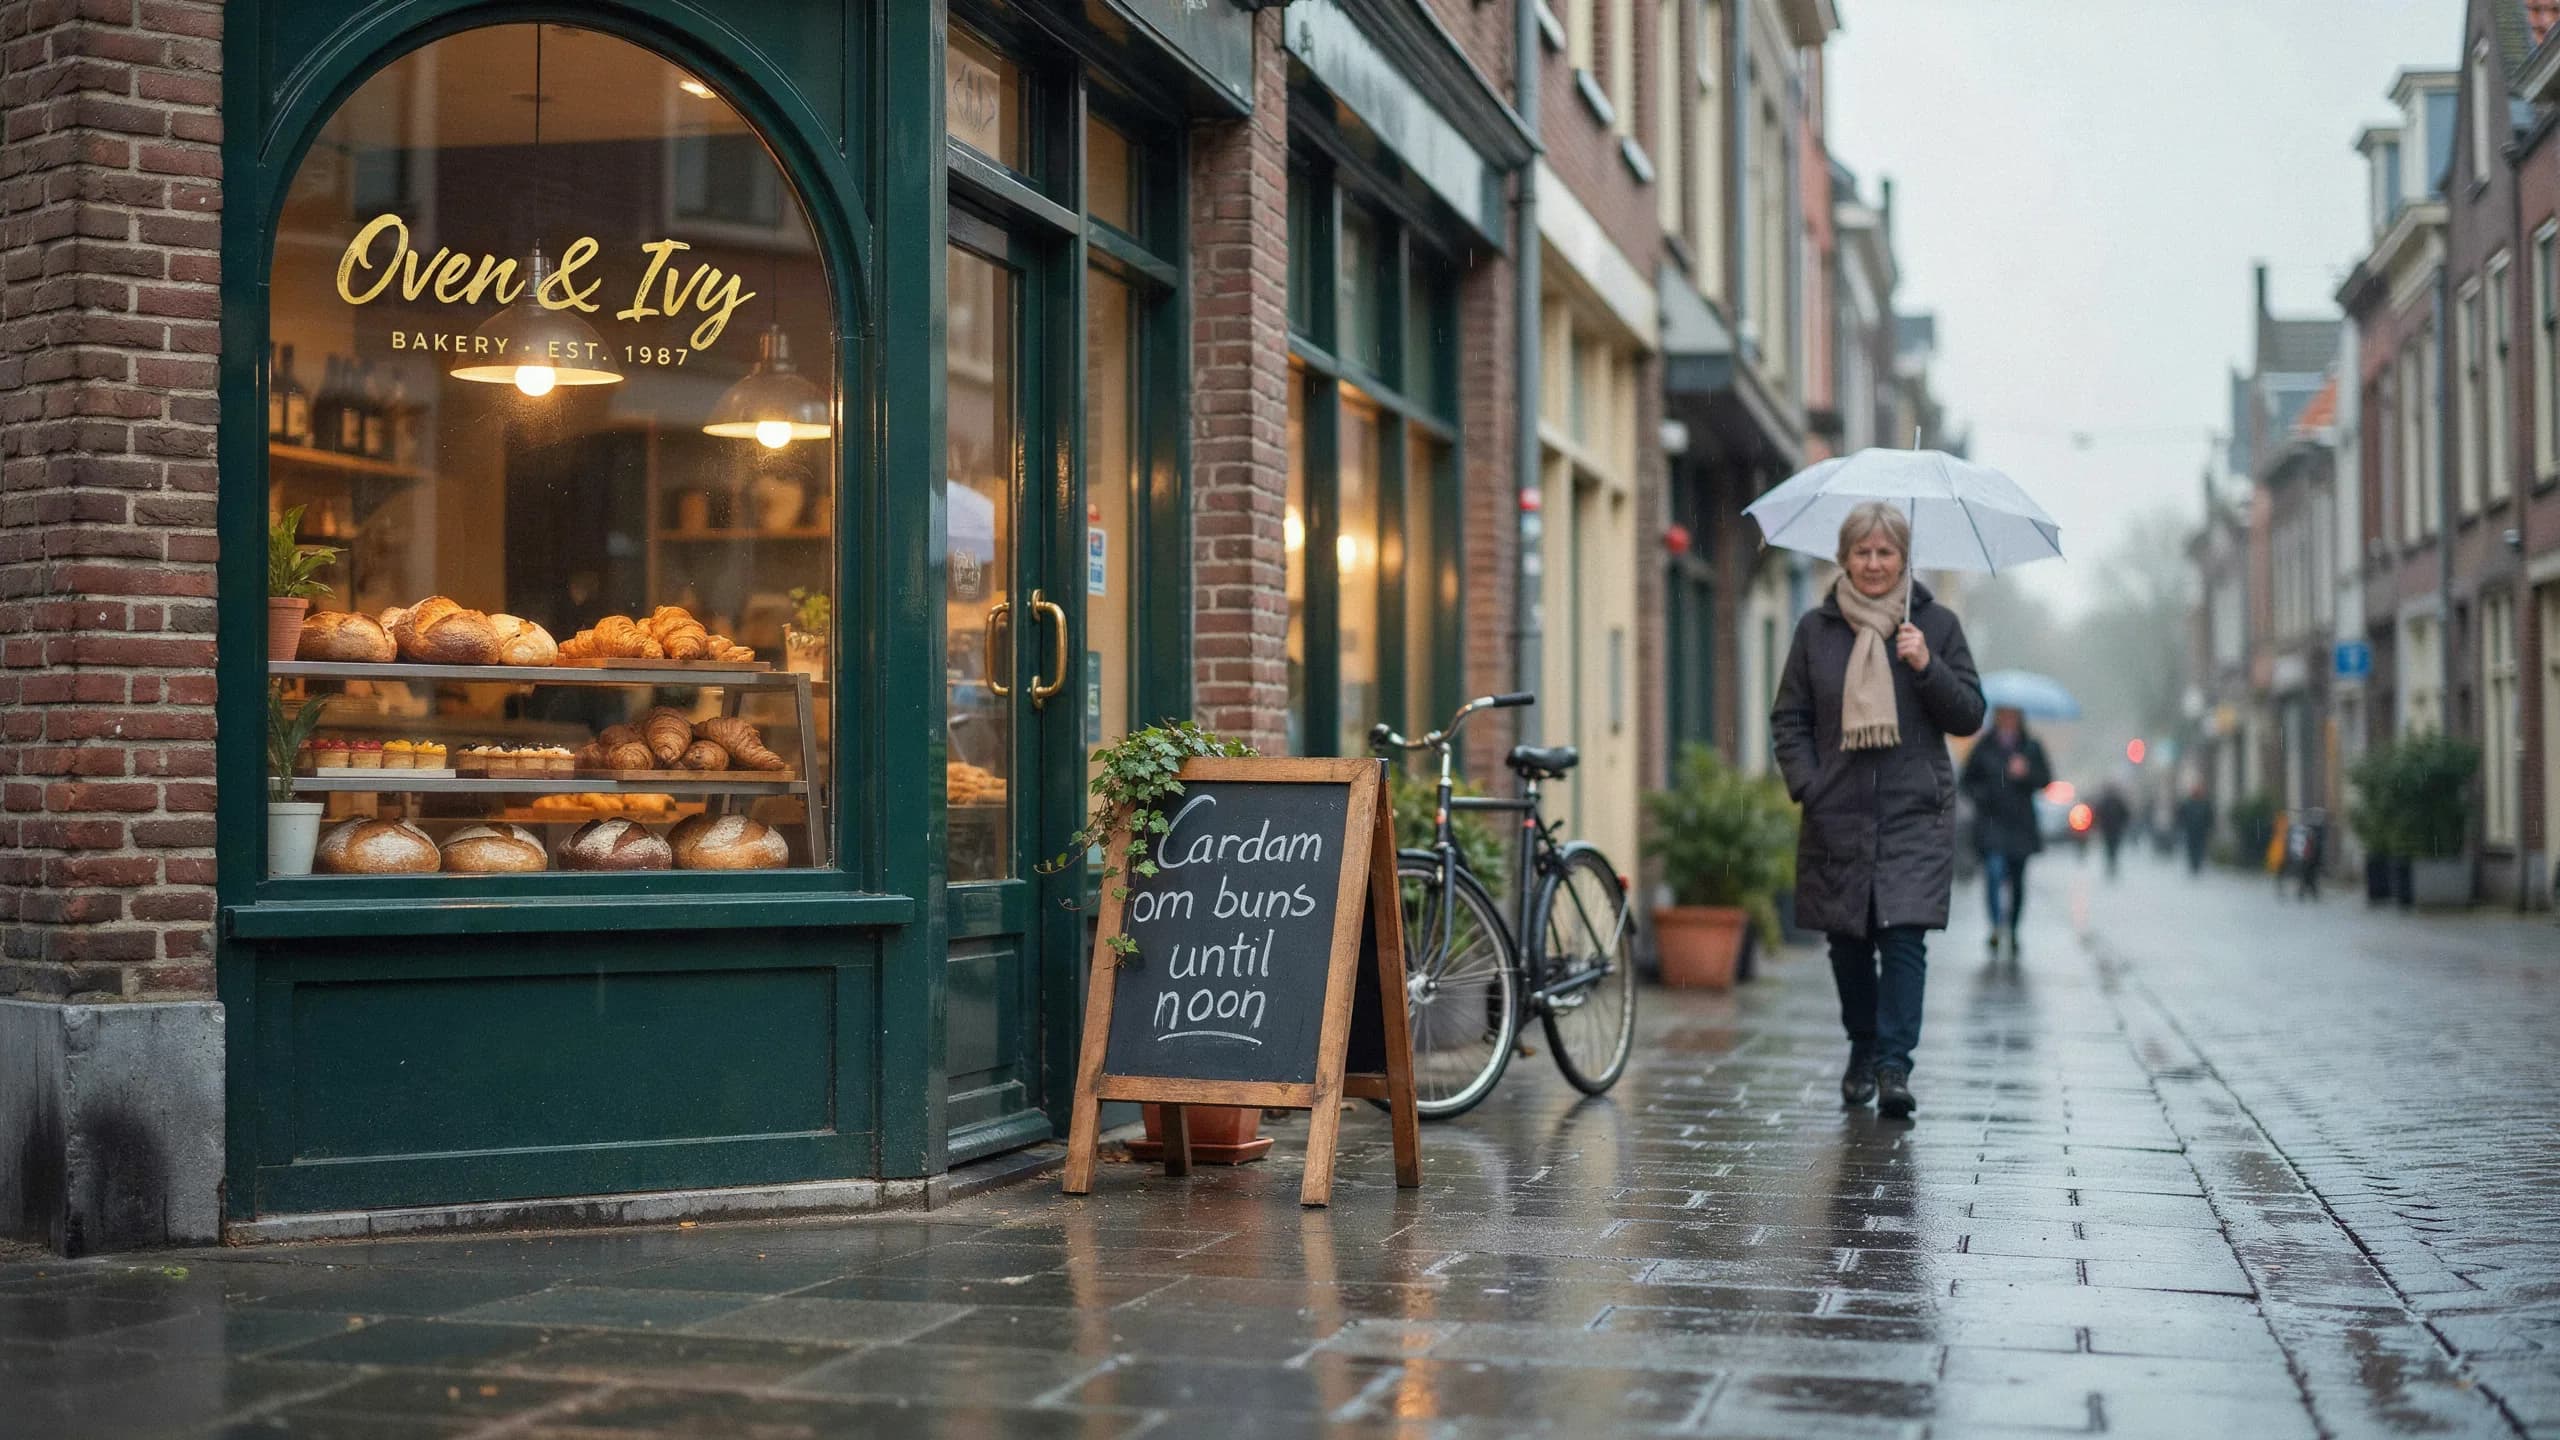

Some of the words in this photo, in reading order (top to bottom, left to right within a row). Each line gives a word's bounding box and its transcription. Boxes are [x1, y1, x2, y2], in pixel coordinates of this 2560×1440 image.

[336, 213, 526, 305] Oven
[536, 236, 601, 313] &
[616, 239, 757, 351] Ivy
[392, 331, 510, 355] BAKERY
[548, 341, 608, 361] EST.
[625, 345, 689, 366] 1987
[1157, 794, 1322, 869] Cardam
[1133, 889, 1194, 923] om
[1213, 875, 1316, 919] buns
[1169, 929, 1275, 980] until
[1154, 987, 1267, 1031] noon
